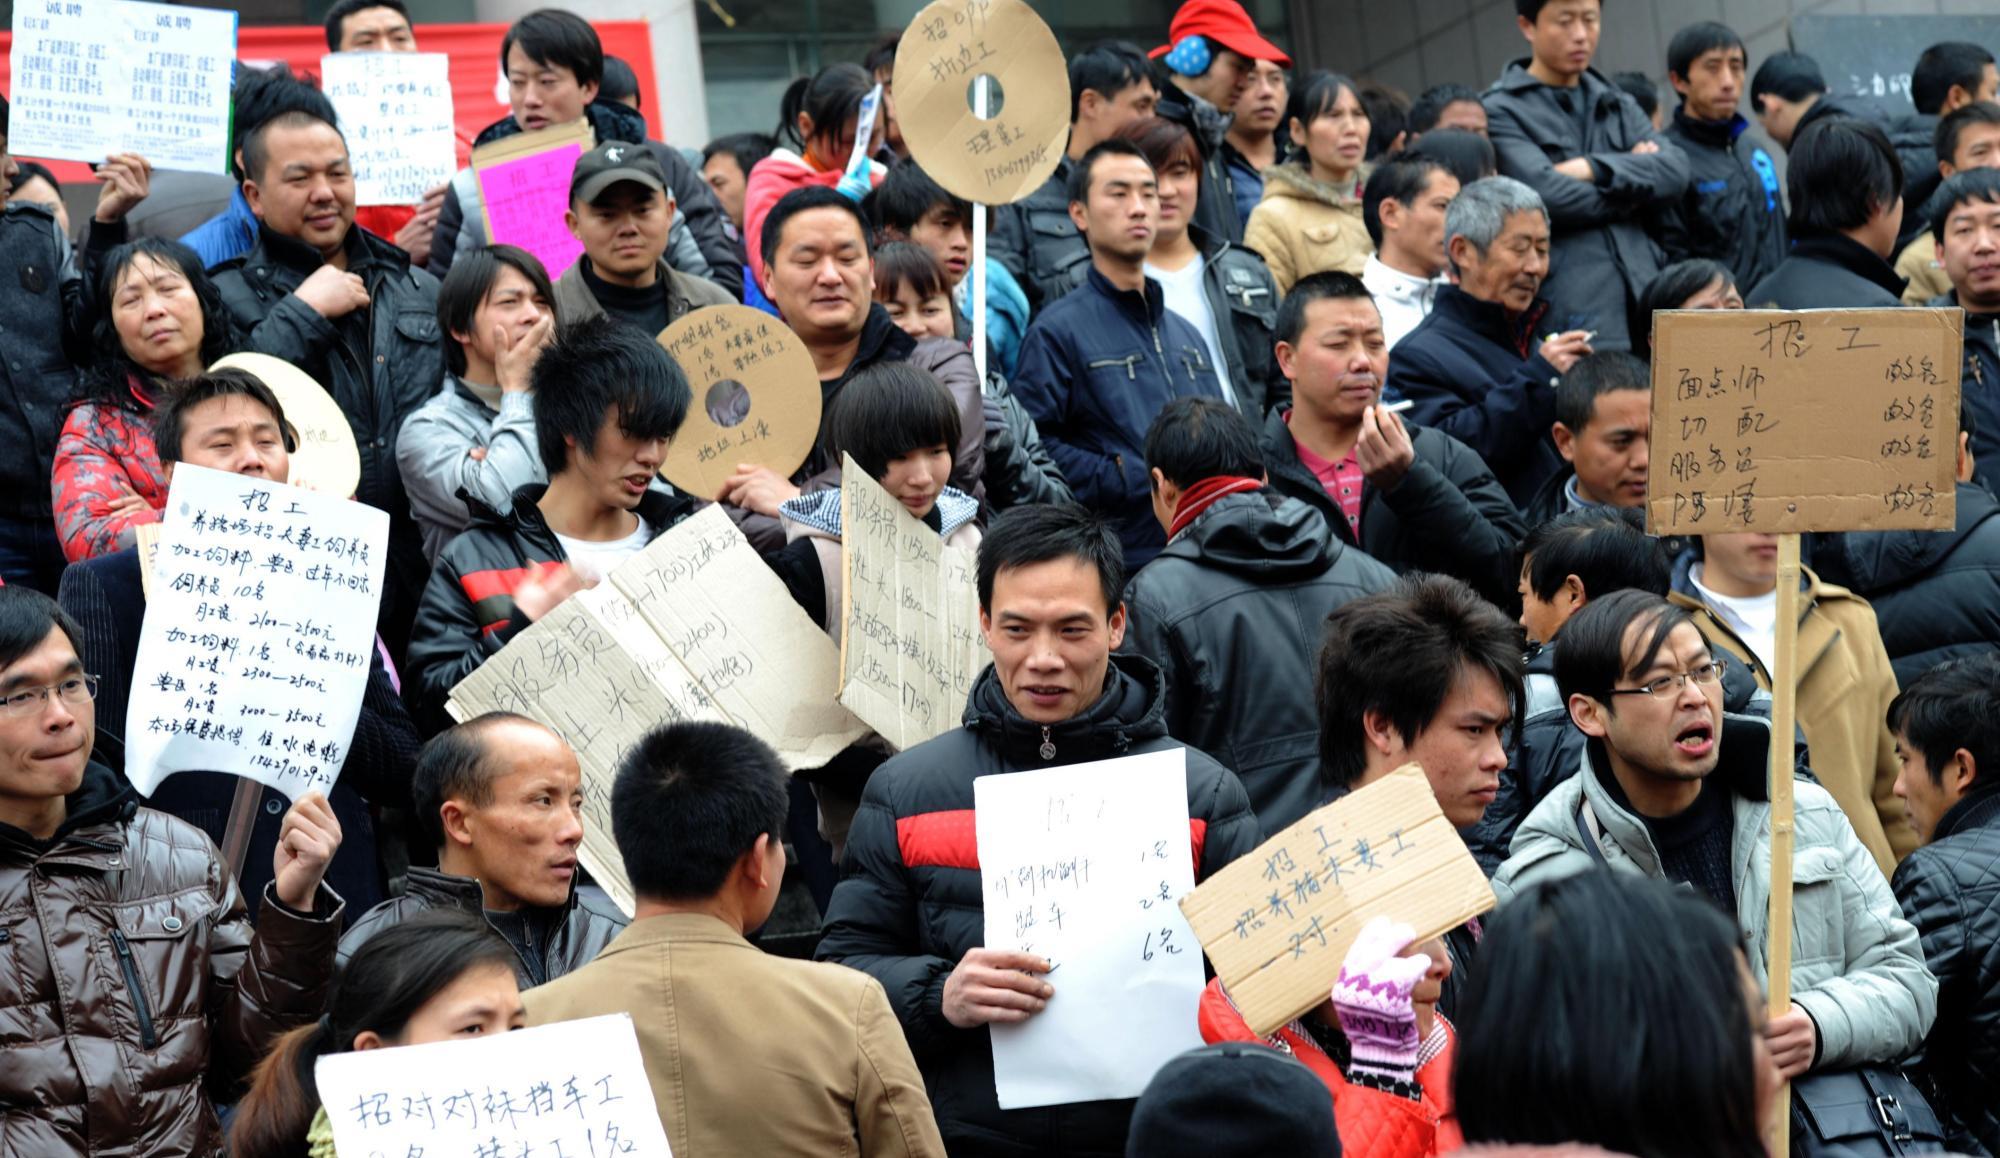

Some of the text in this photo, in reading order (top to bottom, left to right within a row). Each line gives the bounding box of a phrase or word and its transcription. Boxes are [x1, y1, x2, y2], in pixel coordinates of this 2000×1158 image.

[46, 1, 82, 17] 诚聘
[156, 14, 192, 30] 诚聘
[1753, 319, 1881, 358] 招工
[1677, 364, 1765, 401] 面点师
[238, 488, 308, 515] 招工
[850, 480, 898, 553] 服务员
[233, 580, 266, 601] 10名
[1262, 824, 1343, 882] 招工
[1233, 828, 1417, 940] 招养猪夫妻工
[1142, 927, 1184, 962] 6名
